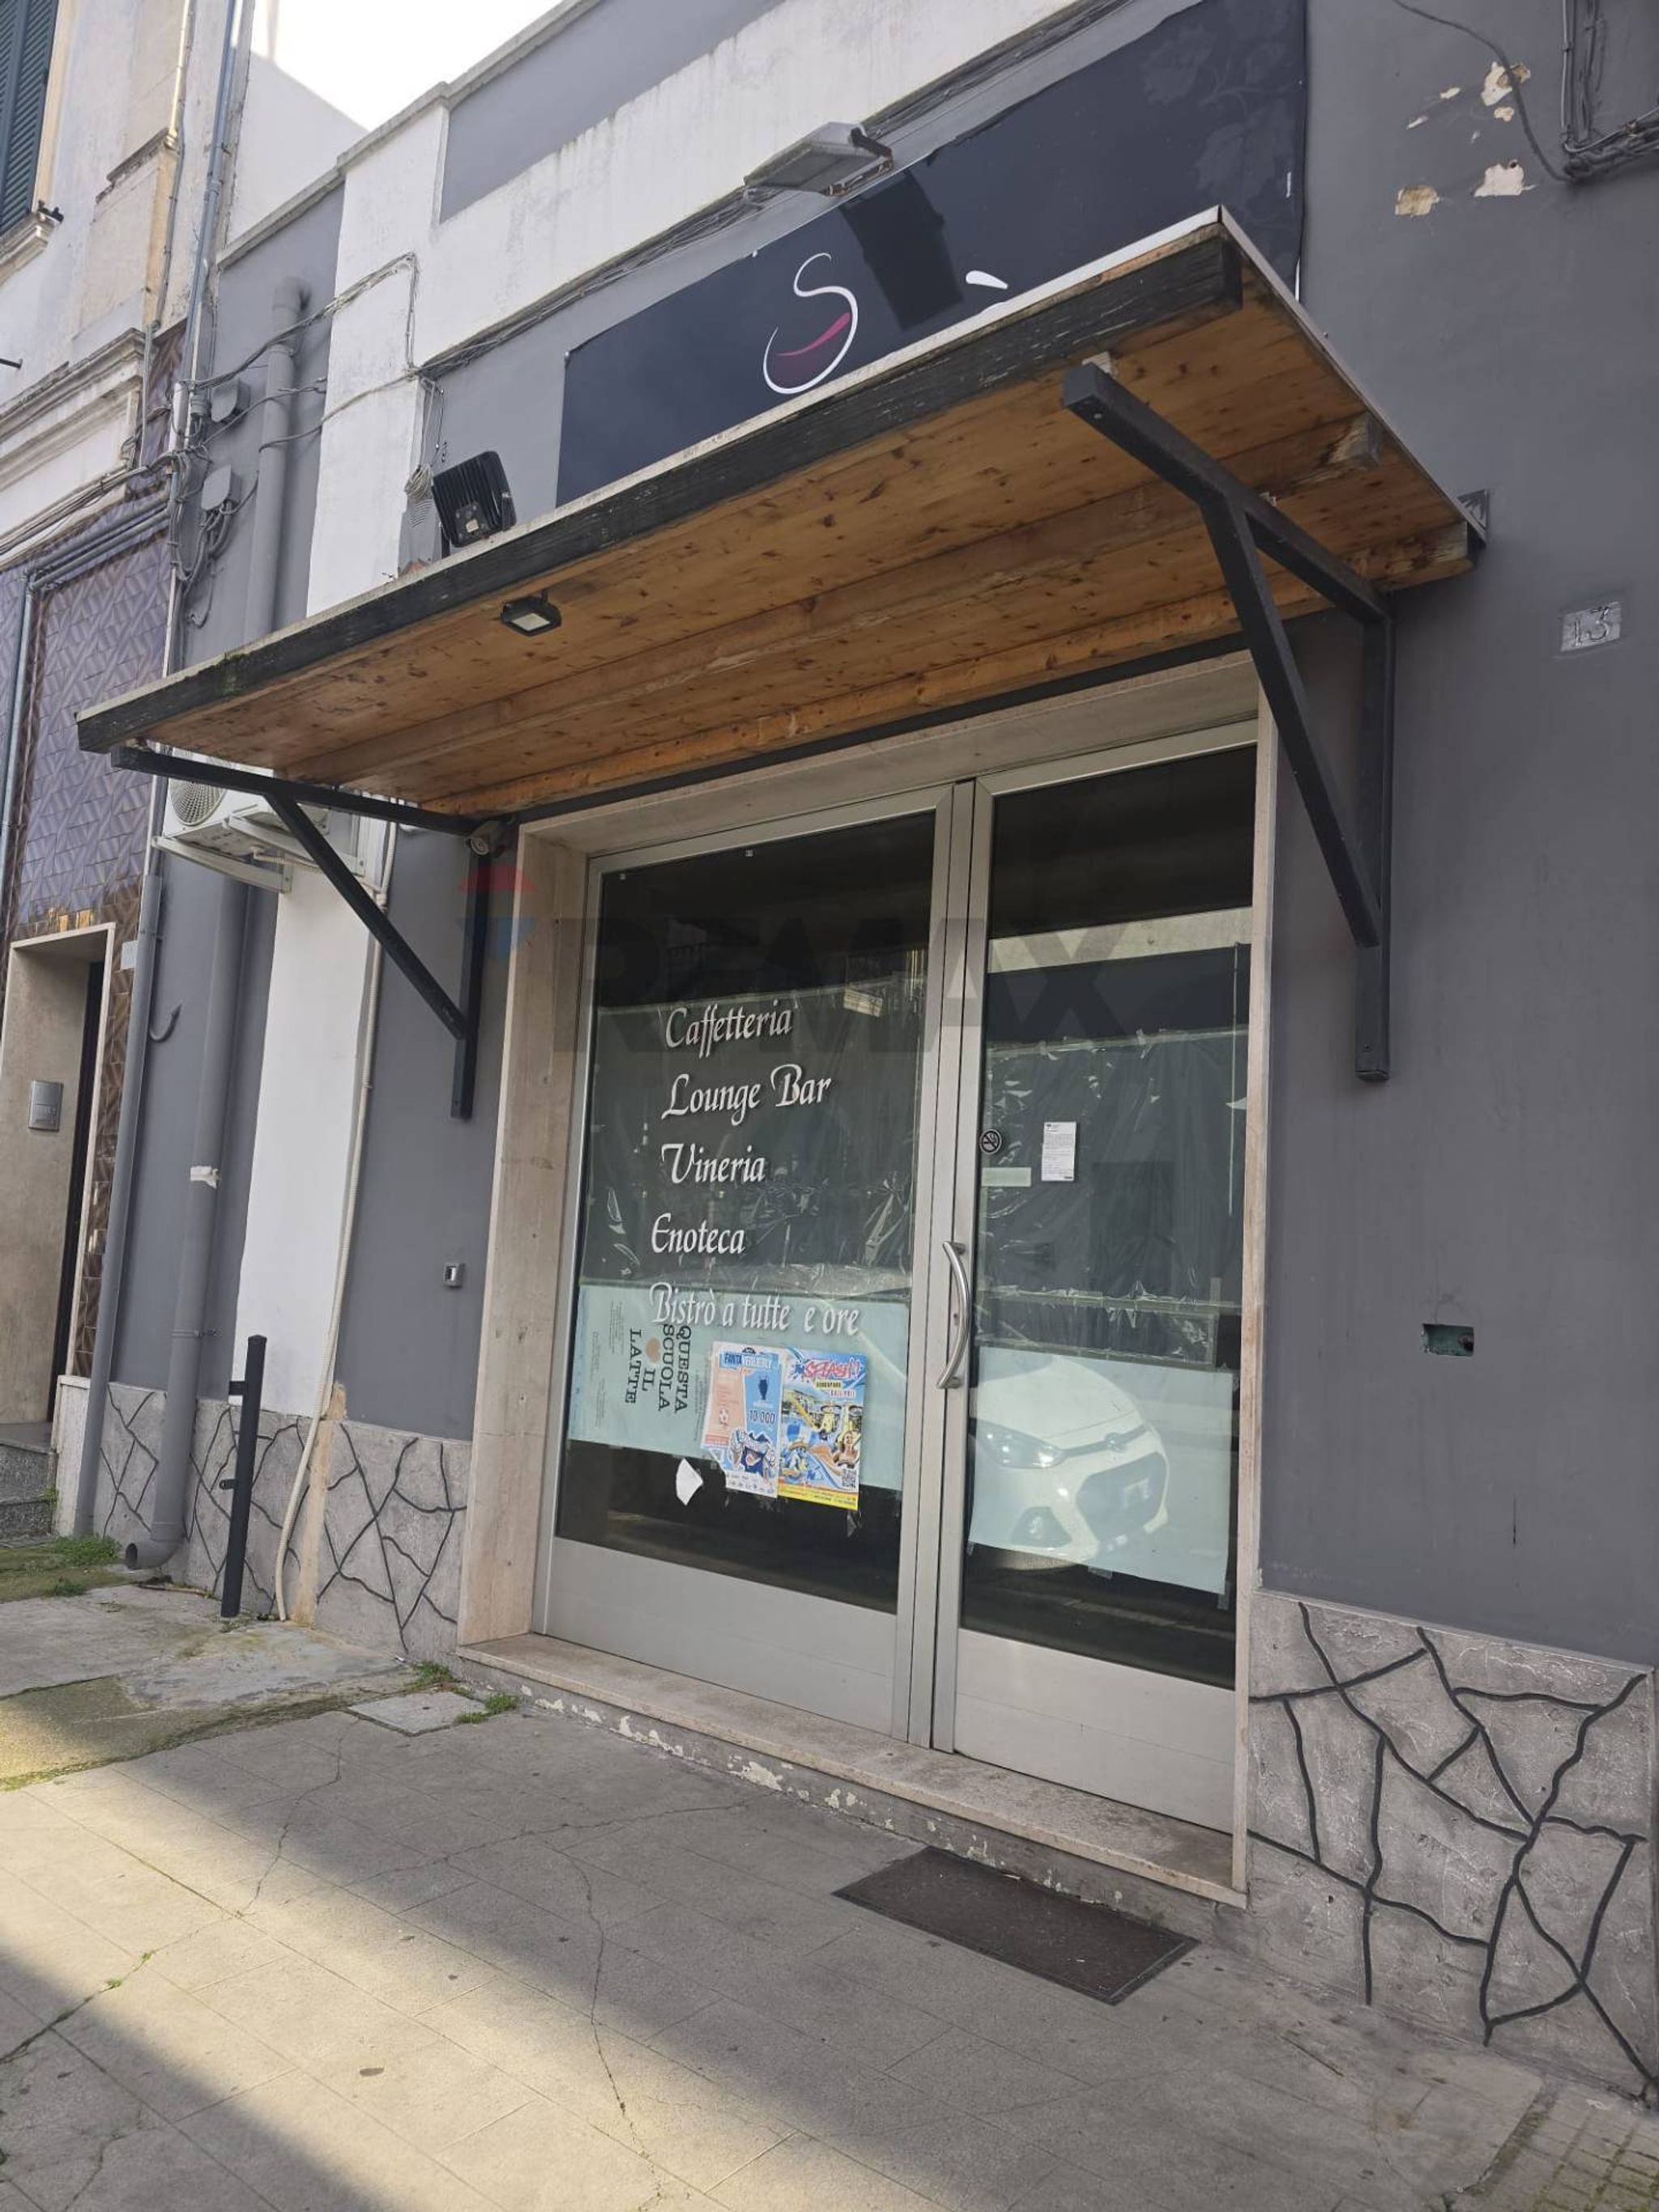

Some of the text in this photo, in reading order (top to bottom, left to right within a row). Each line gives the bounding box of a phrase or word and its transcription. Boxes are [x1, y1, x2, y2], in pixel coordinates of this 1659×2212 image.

[665, 999, 792, 1058] Caffetteria
[661, 1063, 832, 1126] Lounge Bar
[661, 1143, 766, 1184] Vineria
[651, 1213, 746, 1254] Enoteca
[650, 1281, 715, 1326] Bistrò
[722, 1302, 734, 1327] a
[742, 1294, 791, 1331] tutte
[822, 1307, 859, 1336] ore
[625, 1328, 642, 1404] LATTE
[642, 1367, 655, 1392] IL
[658, 1323, 675, 1411] SCUOLA
[674, 1325, 692, 1413] QUESTA
